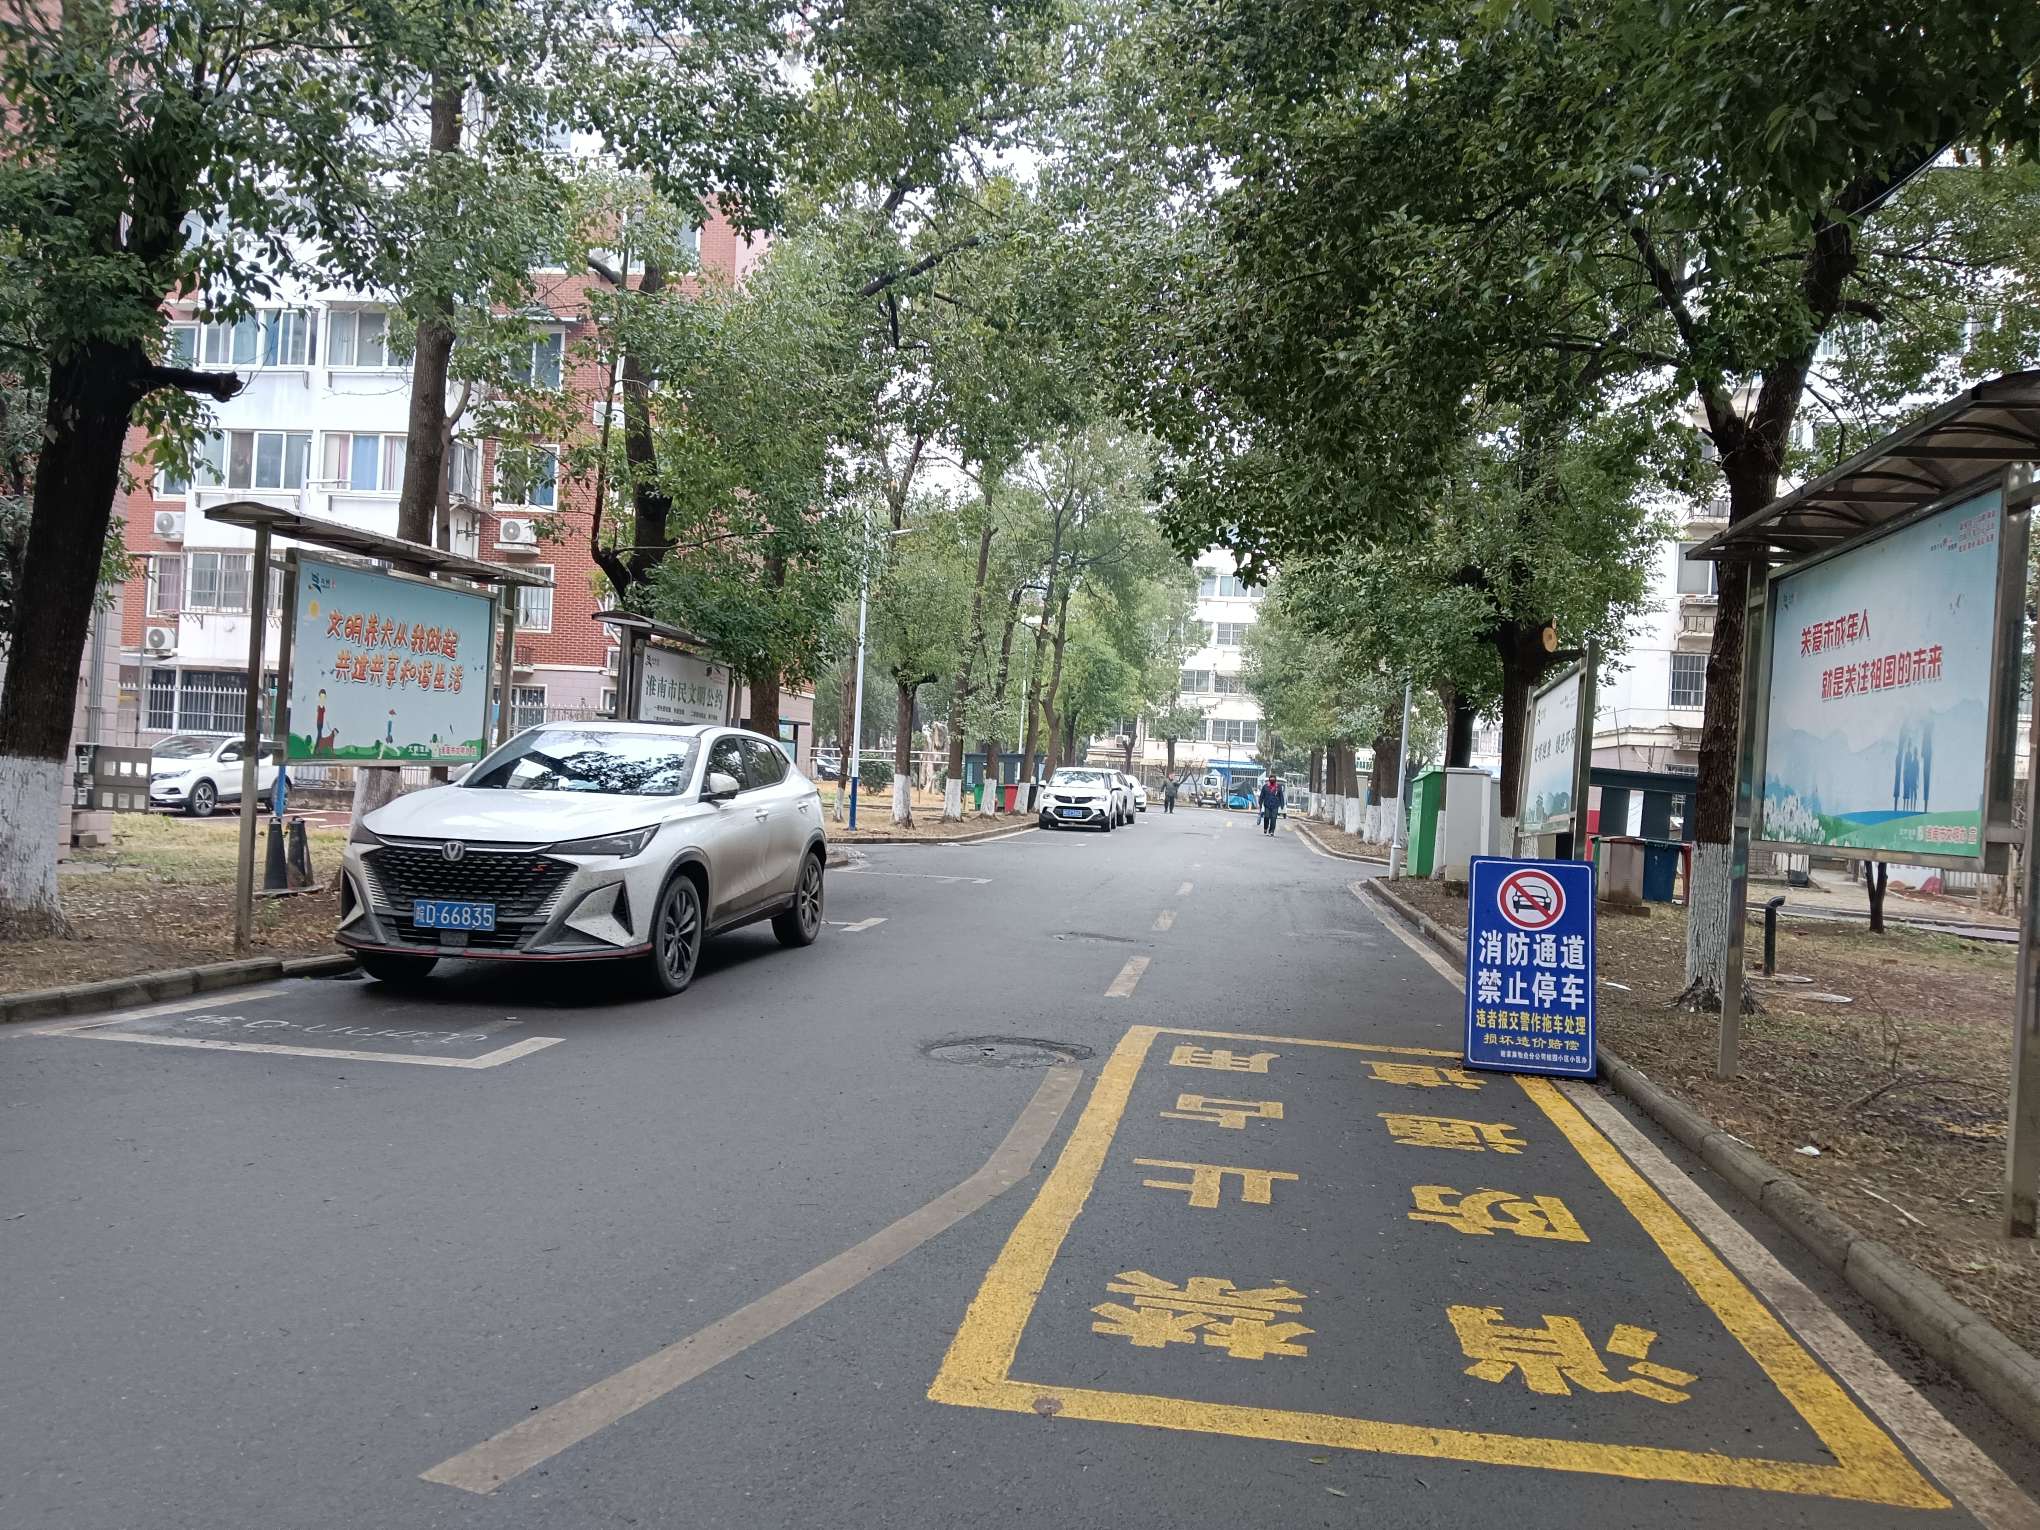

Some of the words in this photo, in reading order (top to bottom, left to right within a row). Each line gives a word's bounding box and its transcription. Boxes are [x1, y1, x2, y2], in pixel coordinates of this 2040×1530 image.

[326, 609, 459, 660] 文明养犬从我做起
[1801, 608, 1870, 655] 关爱未成年人
[334, 649, 464, 694] 共建共享和谐生活
[645, 675, 723, 710] 淮南市民文明公约
[1821, 644, 1942, 699] 就是关注祖国的未来
[1478, 929, 1586, 970] 消防通道
[1477, 968, 1585, 1010] 禁止停车
[1475, 1008, 1587, 1035] 违者报交警作拖车处理
[1090, 1044, 1316, 1360] 禁止占用
[1361, 1059, 1699, 1404] 消防通道
